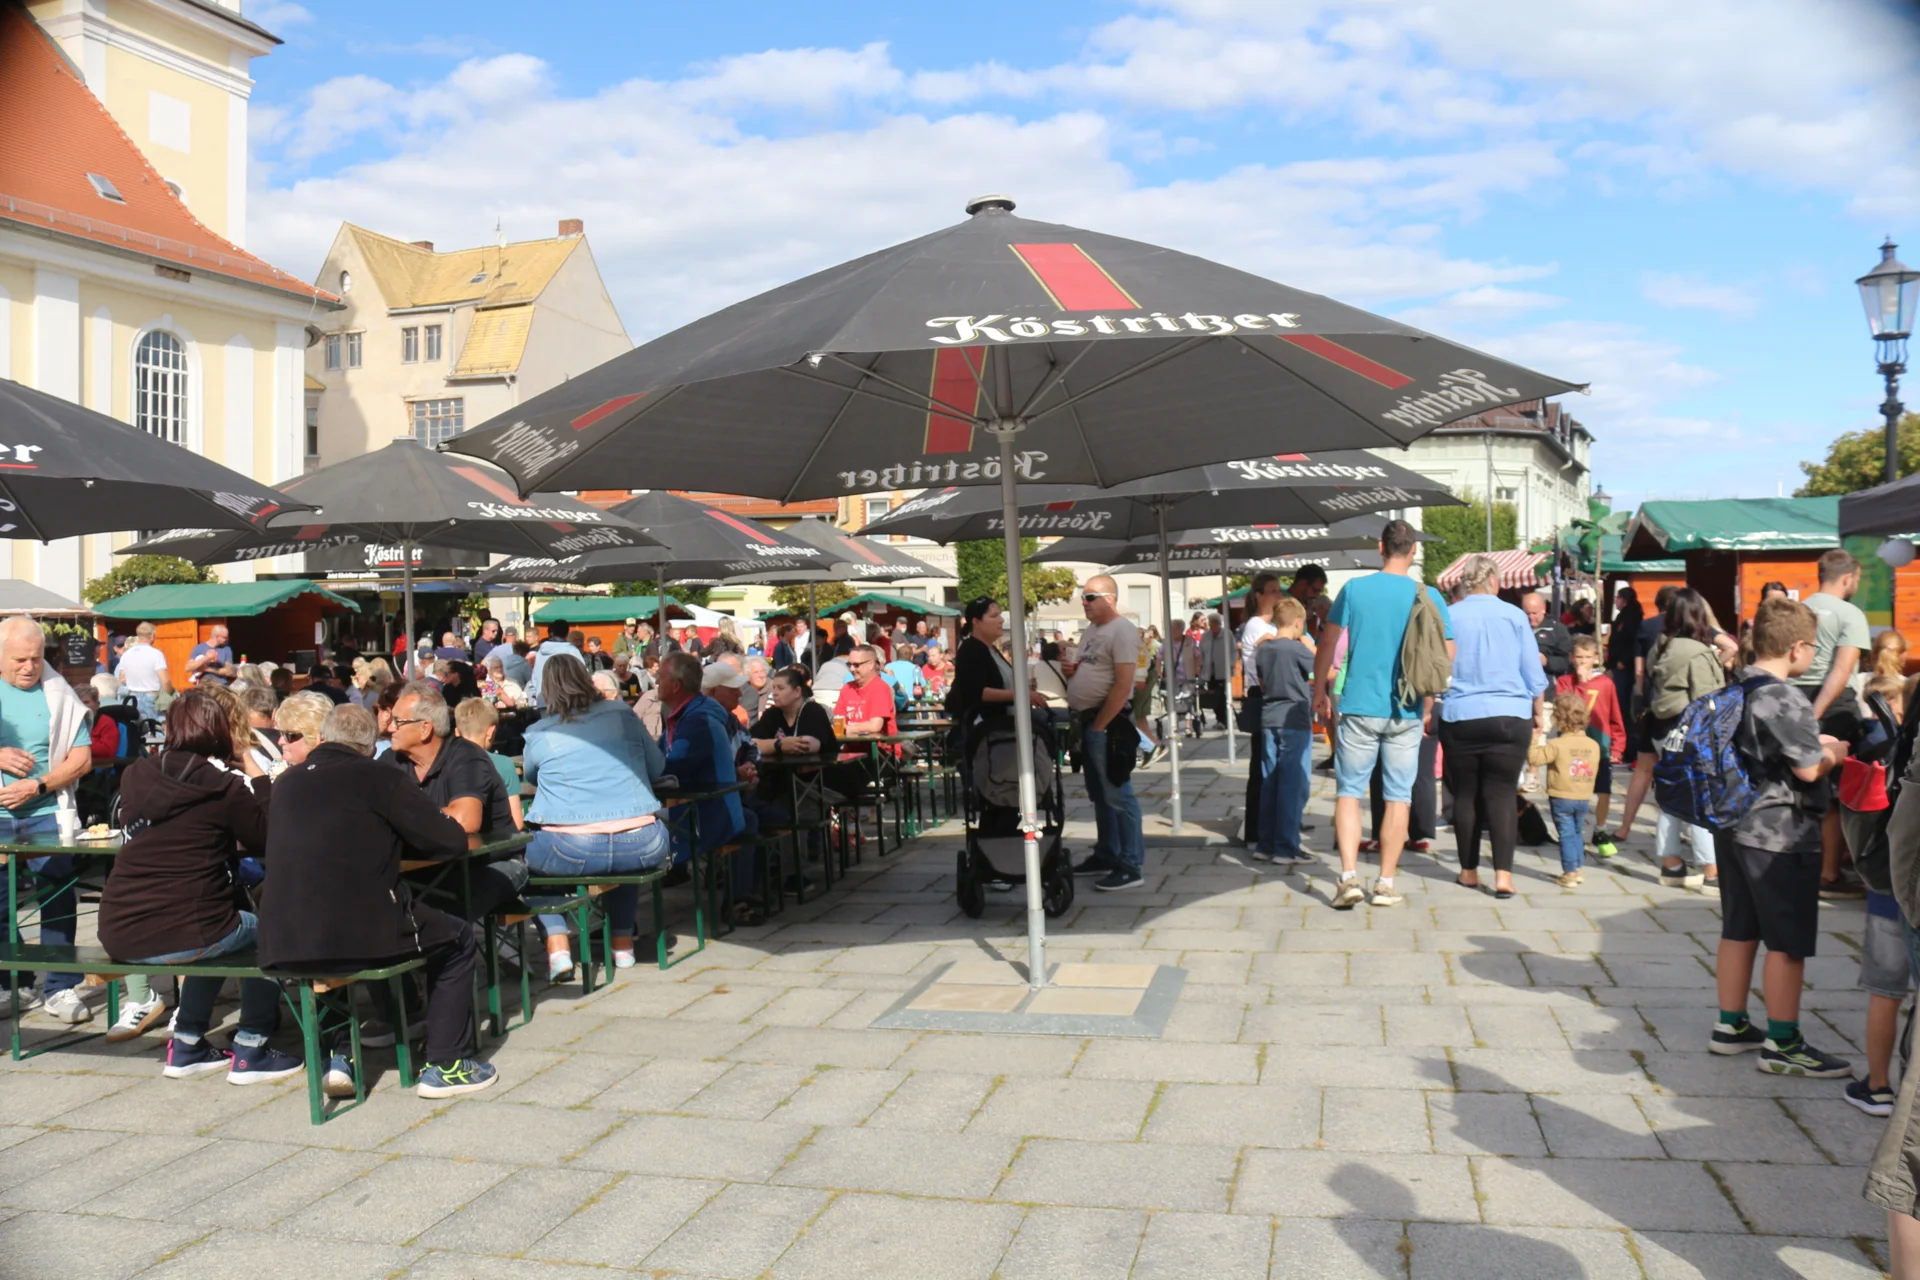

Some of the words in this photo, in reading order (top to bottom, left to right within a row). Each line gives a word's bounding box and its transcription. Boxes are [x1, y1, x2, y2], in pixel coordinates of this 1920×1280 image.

[925, 312, 1301, 345] Köstritzer
[1227, 460, 1389, 481] Köstritzer
[467, 501, 602, 521] Köstritzer
[1210, 527, 1330, 543] Köstritzer
[364, 543, 423, 567] Köstrier
